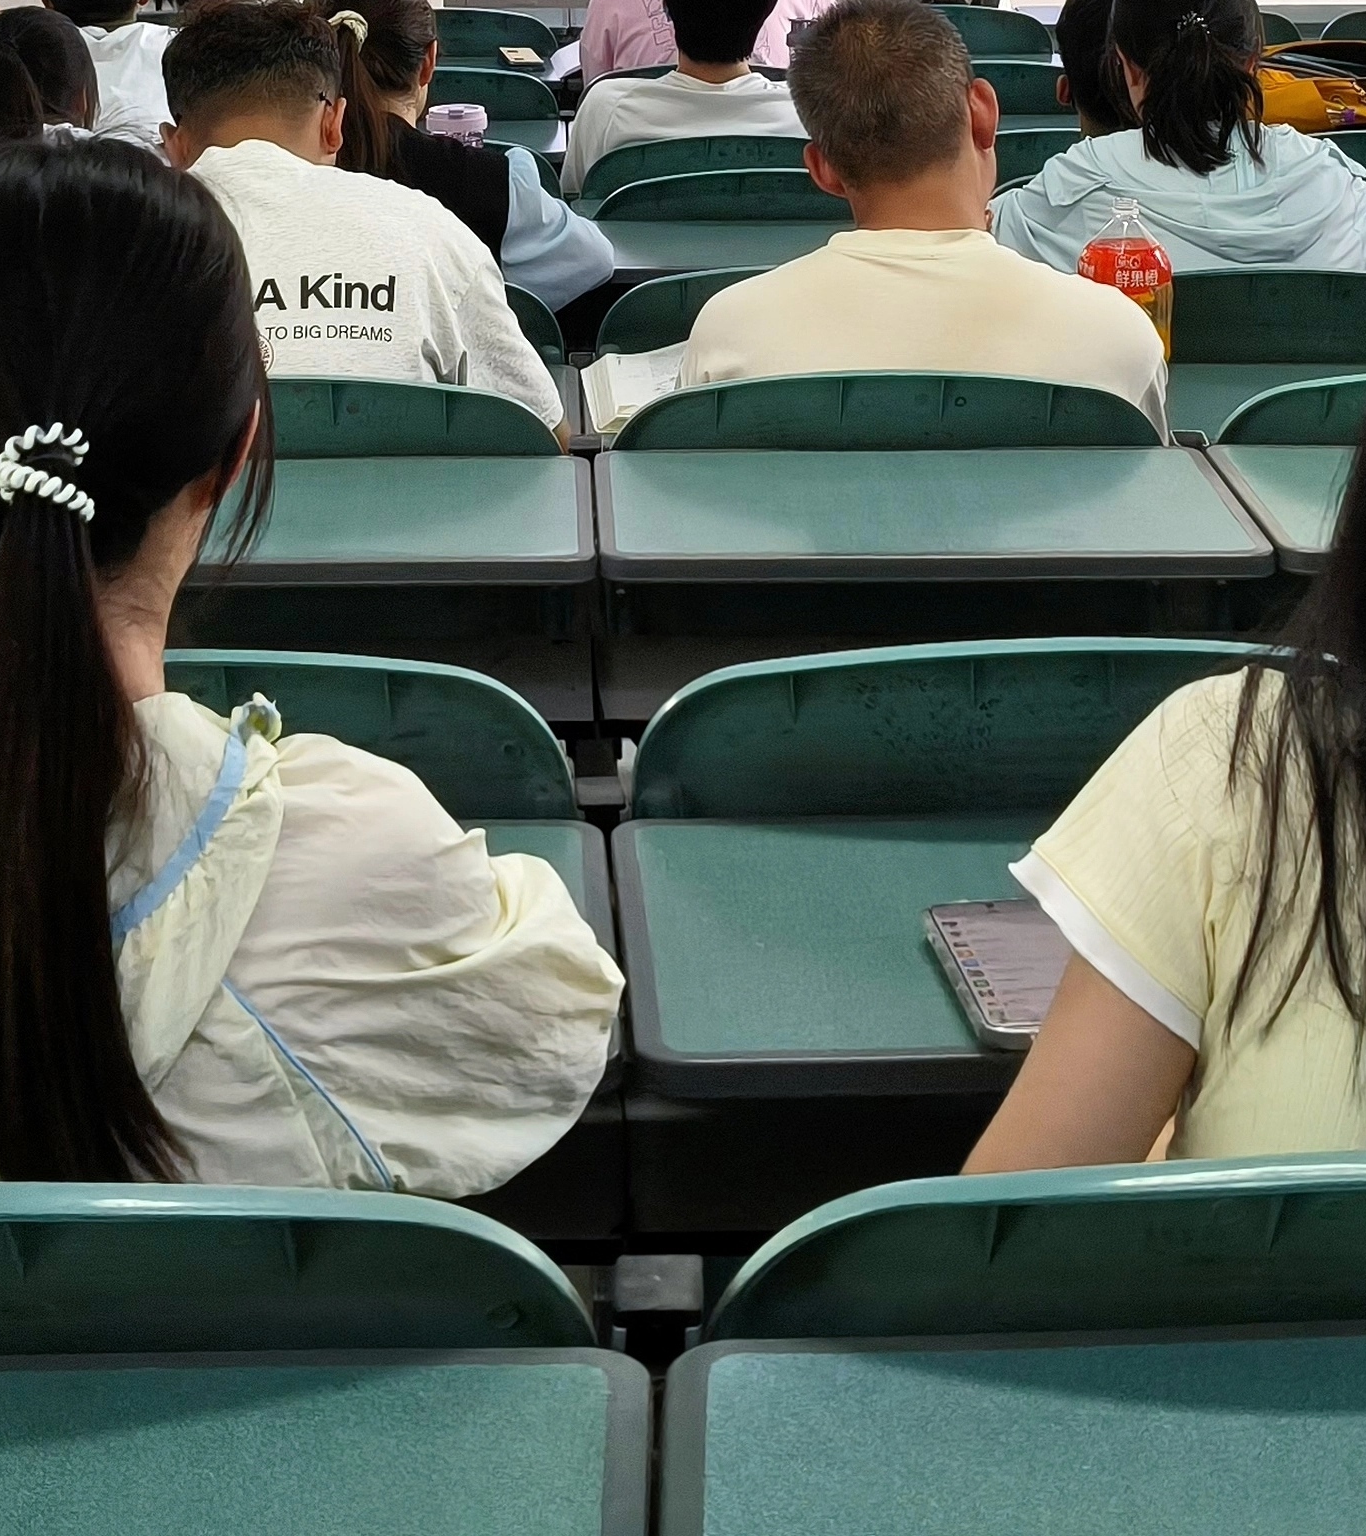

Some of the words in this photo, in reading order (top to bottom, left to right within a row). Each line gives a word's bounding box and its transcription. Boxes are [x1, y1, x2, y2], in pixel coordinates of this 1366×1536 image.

[254, 277, 287, 313] A
[299, 272, 397, 313] Kind
[265, 326, 287, 340] TO
[293, 325, 322, 340] BIG
[326, 325, 393, 343] DREAMS
